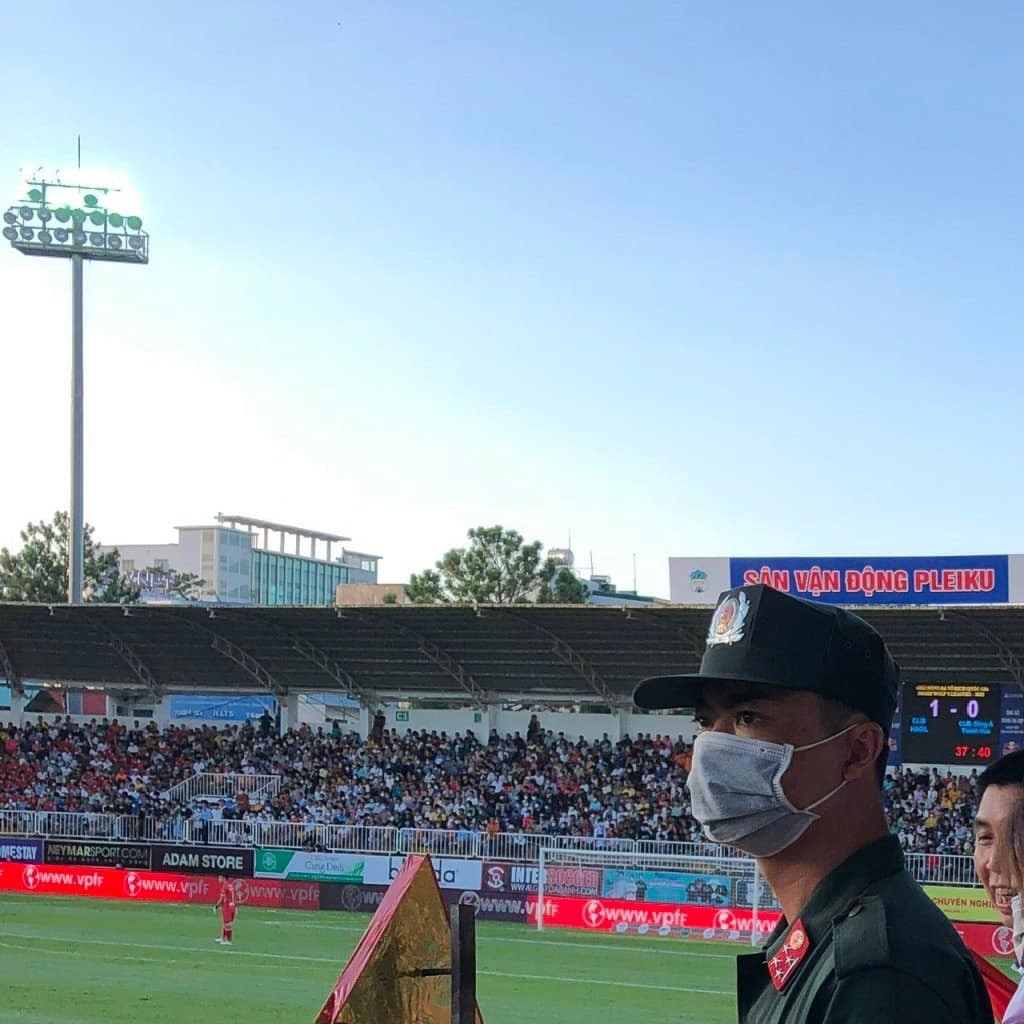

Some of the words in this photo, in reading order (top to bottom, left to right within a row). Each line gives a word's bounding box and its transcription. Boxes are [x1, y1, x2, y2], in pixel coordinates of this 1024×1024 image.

[744, 566, 789, 592] SÂN
[793, 565, 840, 595] VẬN
[845, 565, 909, 596] ĐỘNG
[914, 569, 995, 592] PLEIKU
[930, 699, 939, 717] 1
[967, 699, 979, 718] 0
[0, 845, 38, 860] MESTAY
[47, 844, 149, 859] NEYMARSPORT.COM
[162, 853, 201, 867] ADAM
[202, 854, 244, 870] STORE
